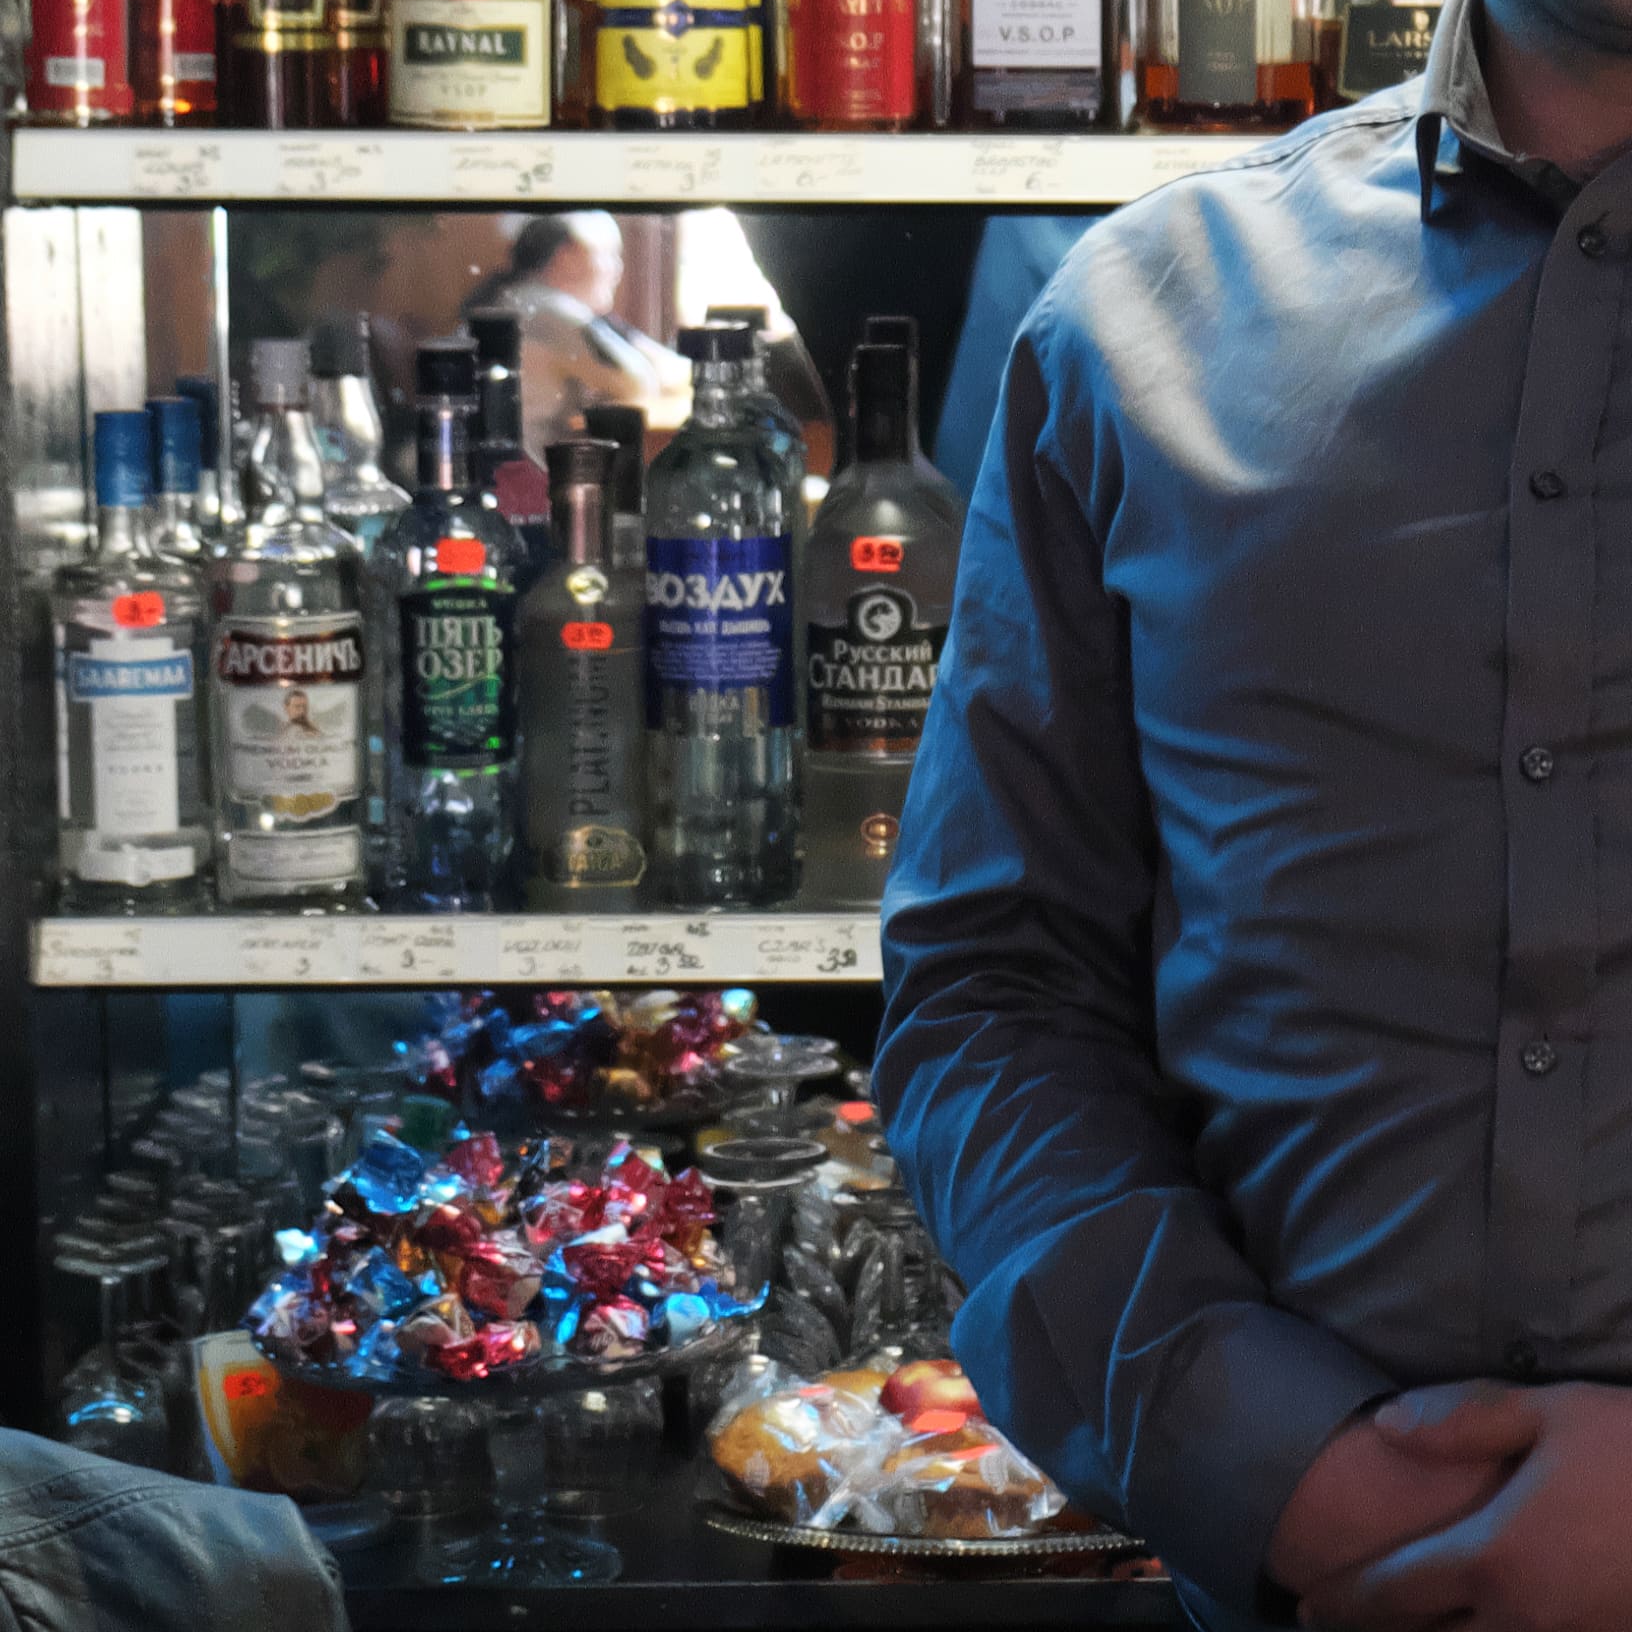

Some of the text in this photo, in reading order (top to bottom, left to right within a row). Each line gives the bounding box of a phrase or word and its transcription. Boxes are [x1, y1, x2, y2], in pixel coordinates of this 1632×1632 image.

[416, 30, 508, 56] RAYNAL
[645, 570, 787, 612] ВОЗДУХ
[417, 615, 503, 648] ПЯТЬ
[225, 638, 361, 676] АРСЕНИЧЪ
[417, 648, 504, 681] ОЗЕР
[833, 639, 933, 665] Русский
[77, 665, 186, 689] SAAREMAA
[266, 757, 329, 770] VODKA
